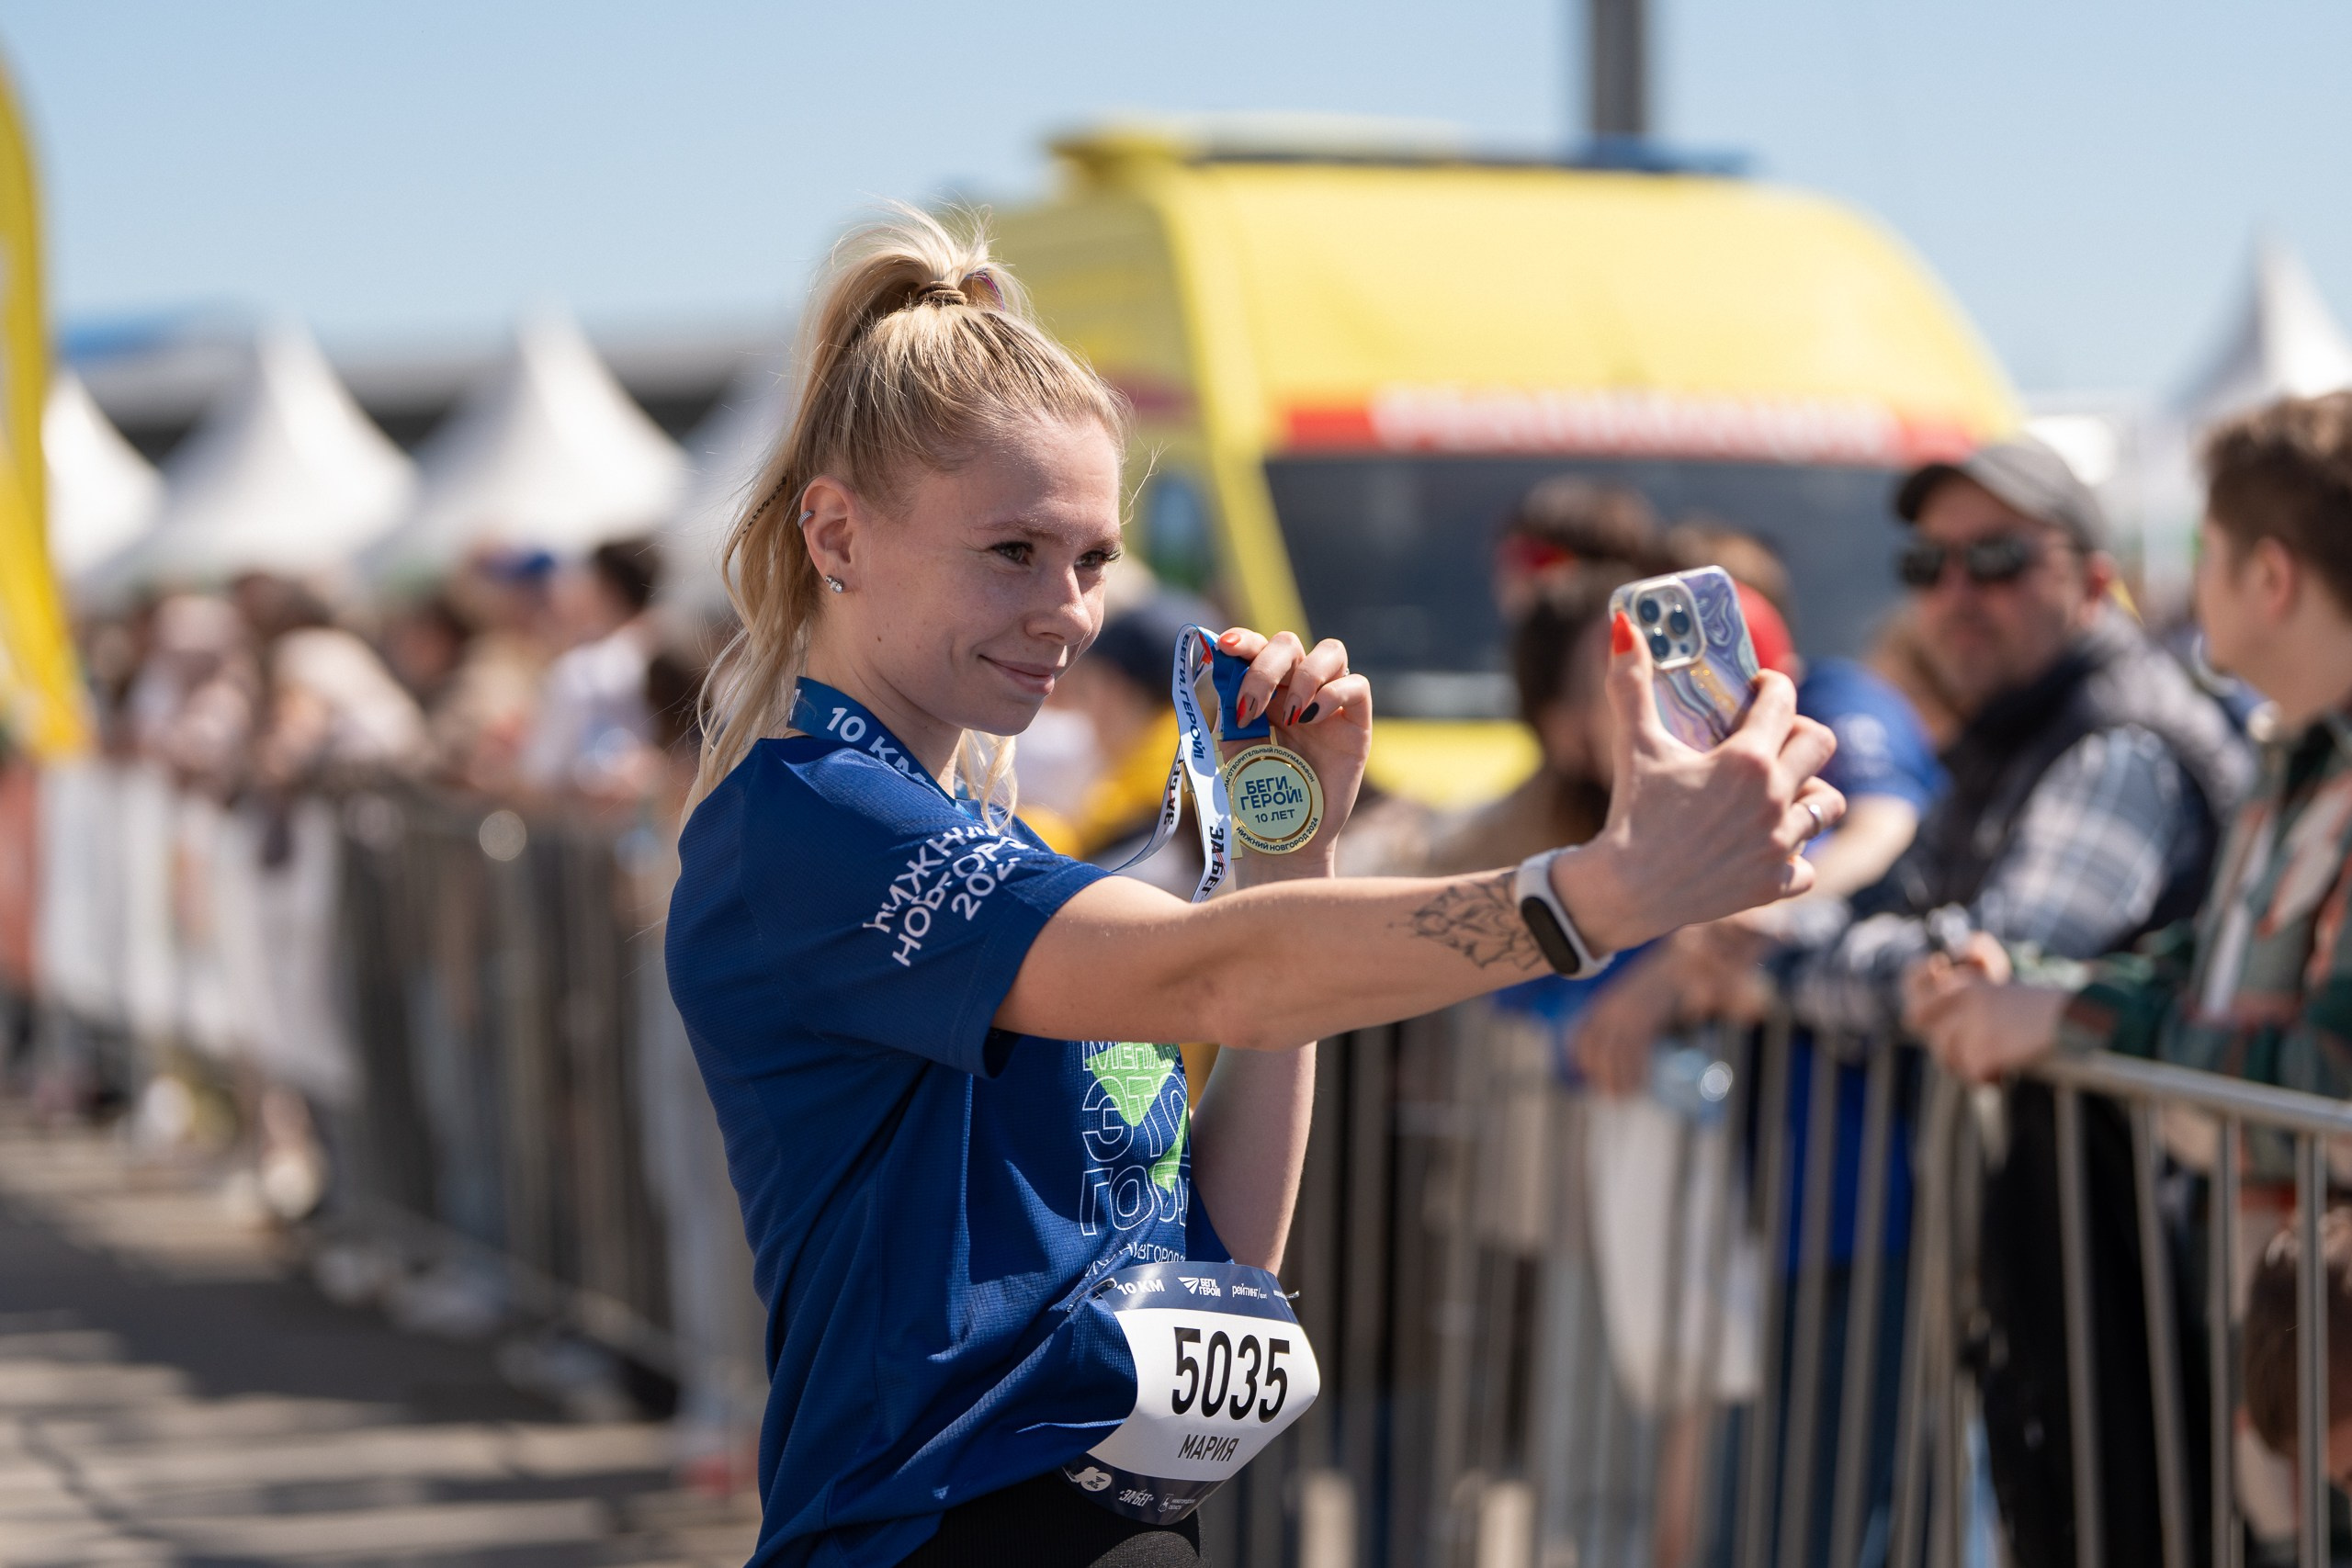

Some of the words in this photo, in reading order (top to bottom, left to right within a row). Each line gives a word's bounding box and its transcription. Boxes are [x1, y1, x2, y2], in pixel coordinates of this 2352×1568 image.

[827, 706, 867, 742] 10
[1273, 748, 1315, 783] ПОЛУМАРАФОН
[1240, 788, 1303, 810] ГЕРОЙ!
[1245, 775, 1293, 795] БЕГИ,
[1255, 813, 1268, 823] 10
[1271, 809, 1295, 821] ЛЕТ
[1236, 827, 1269, 851] НИЖНИЙ
[1269, 832, 1309, 852] НОВГОРОД
[1306, 817, 1318, 835] 2024
[1116, 1282, 1137, 1295] 10
[1136, 1279, 1165, 1293] КМ
[1171, 1326, 1291, 1423] 5035
[1177, 1433, 1240, 1462] МАРИЯ
